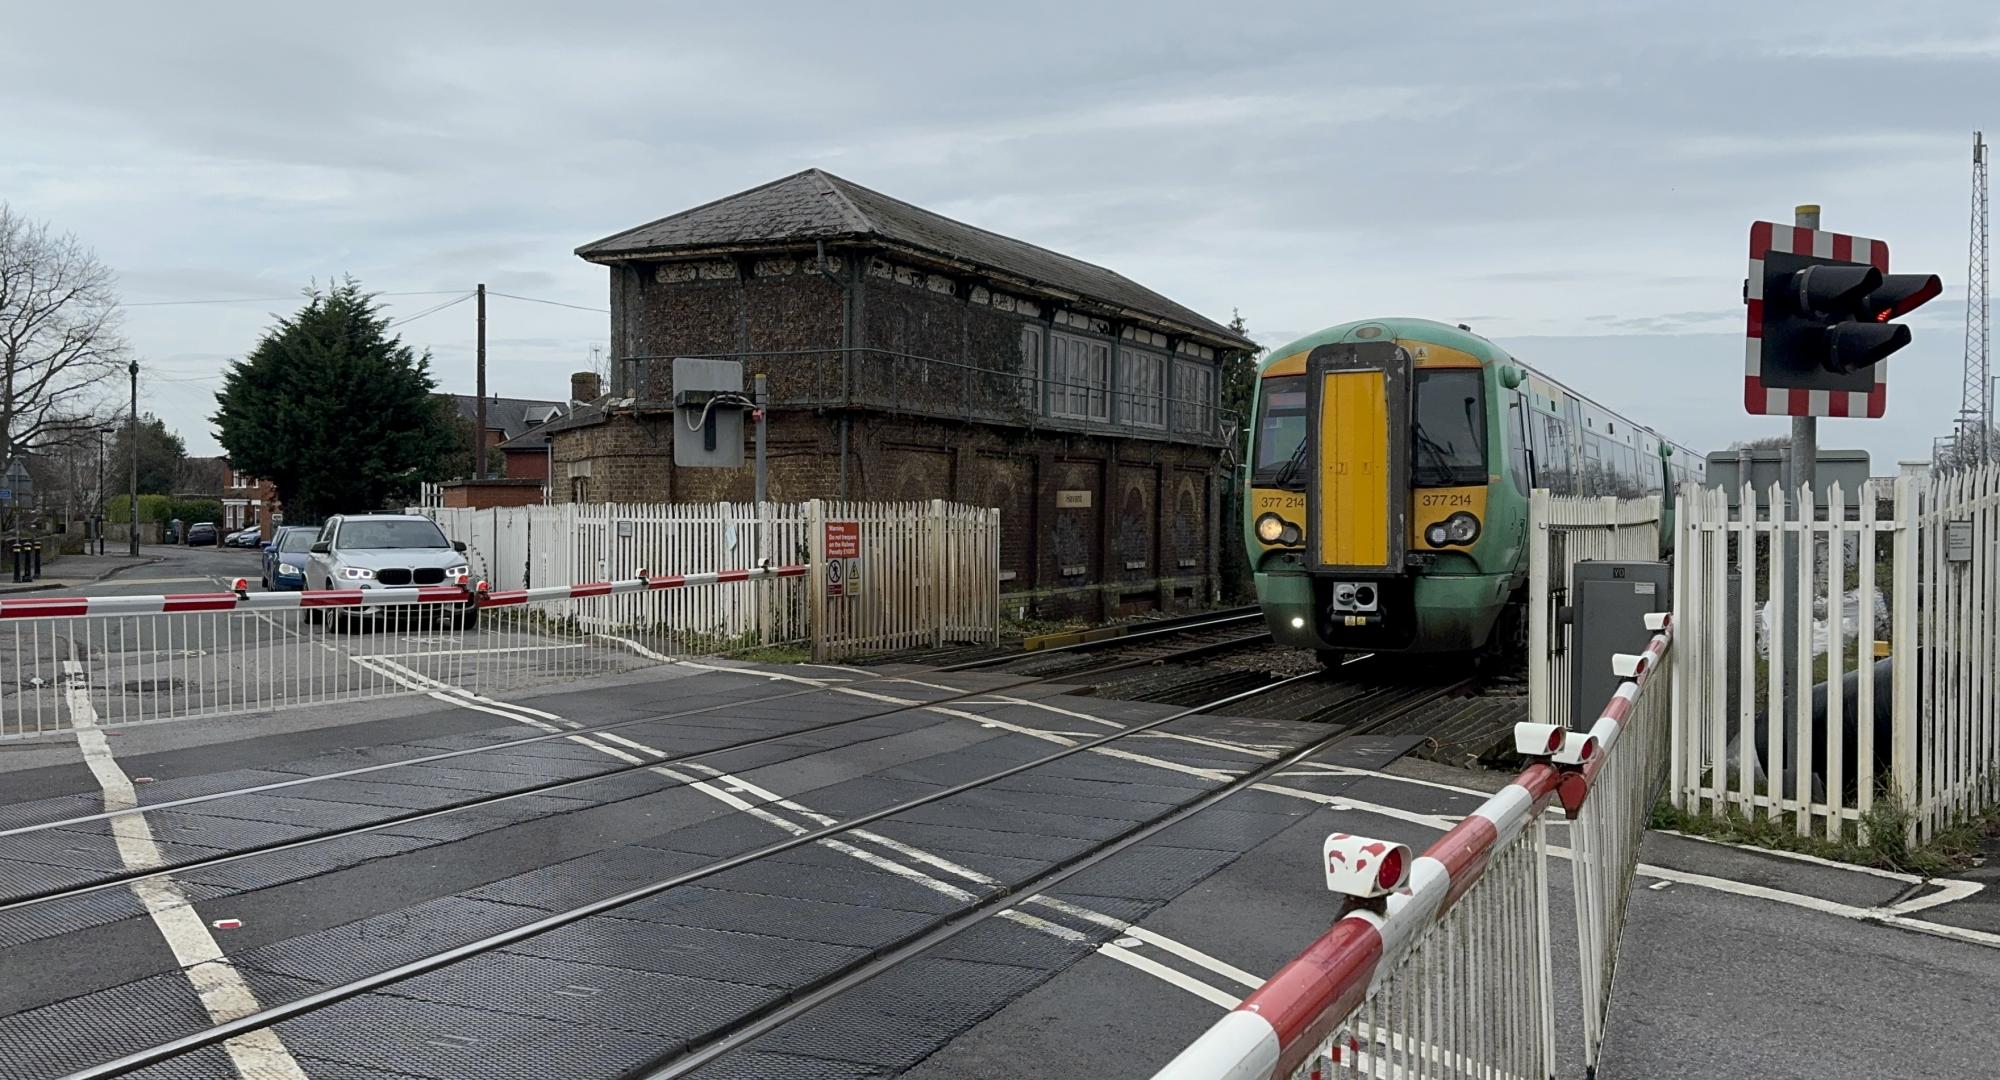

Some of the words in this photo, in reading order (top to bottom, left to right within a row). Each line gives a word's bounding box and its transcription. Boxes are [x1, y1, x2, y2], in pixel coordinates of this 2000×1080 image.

[1261, 497, 1282, 508] 377
[1286, 497, 1304, 508] 214
[1422, 494, 1448, 507] 377
[1450, 494, 1472, 506] 214
[828, 525, 844, 533] Warning
